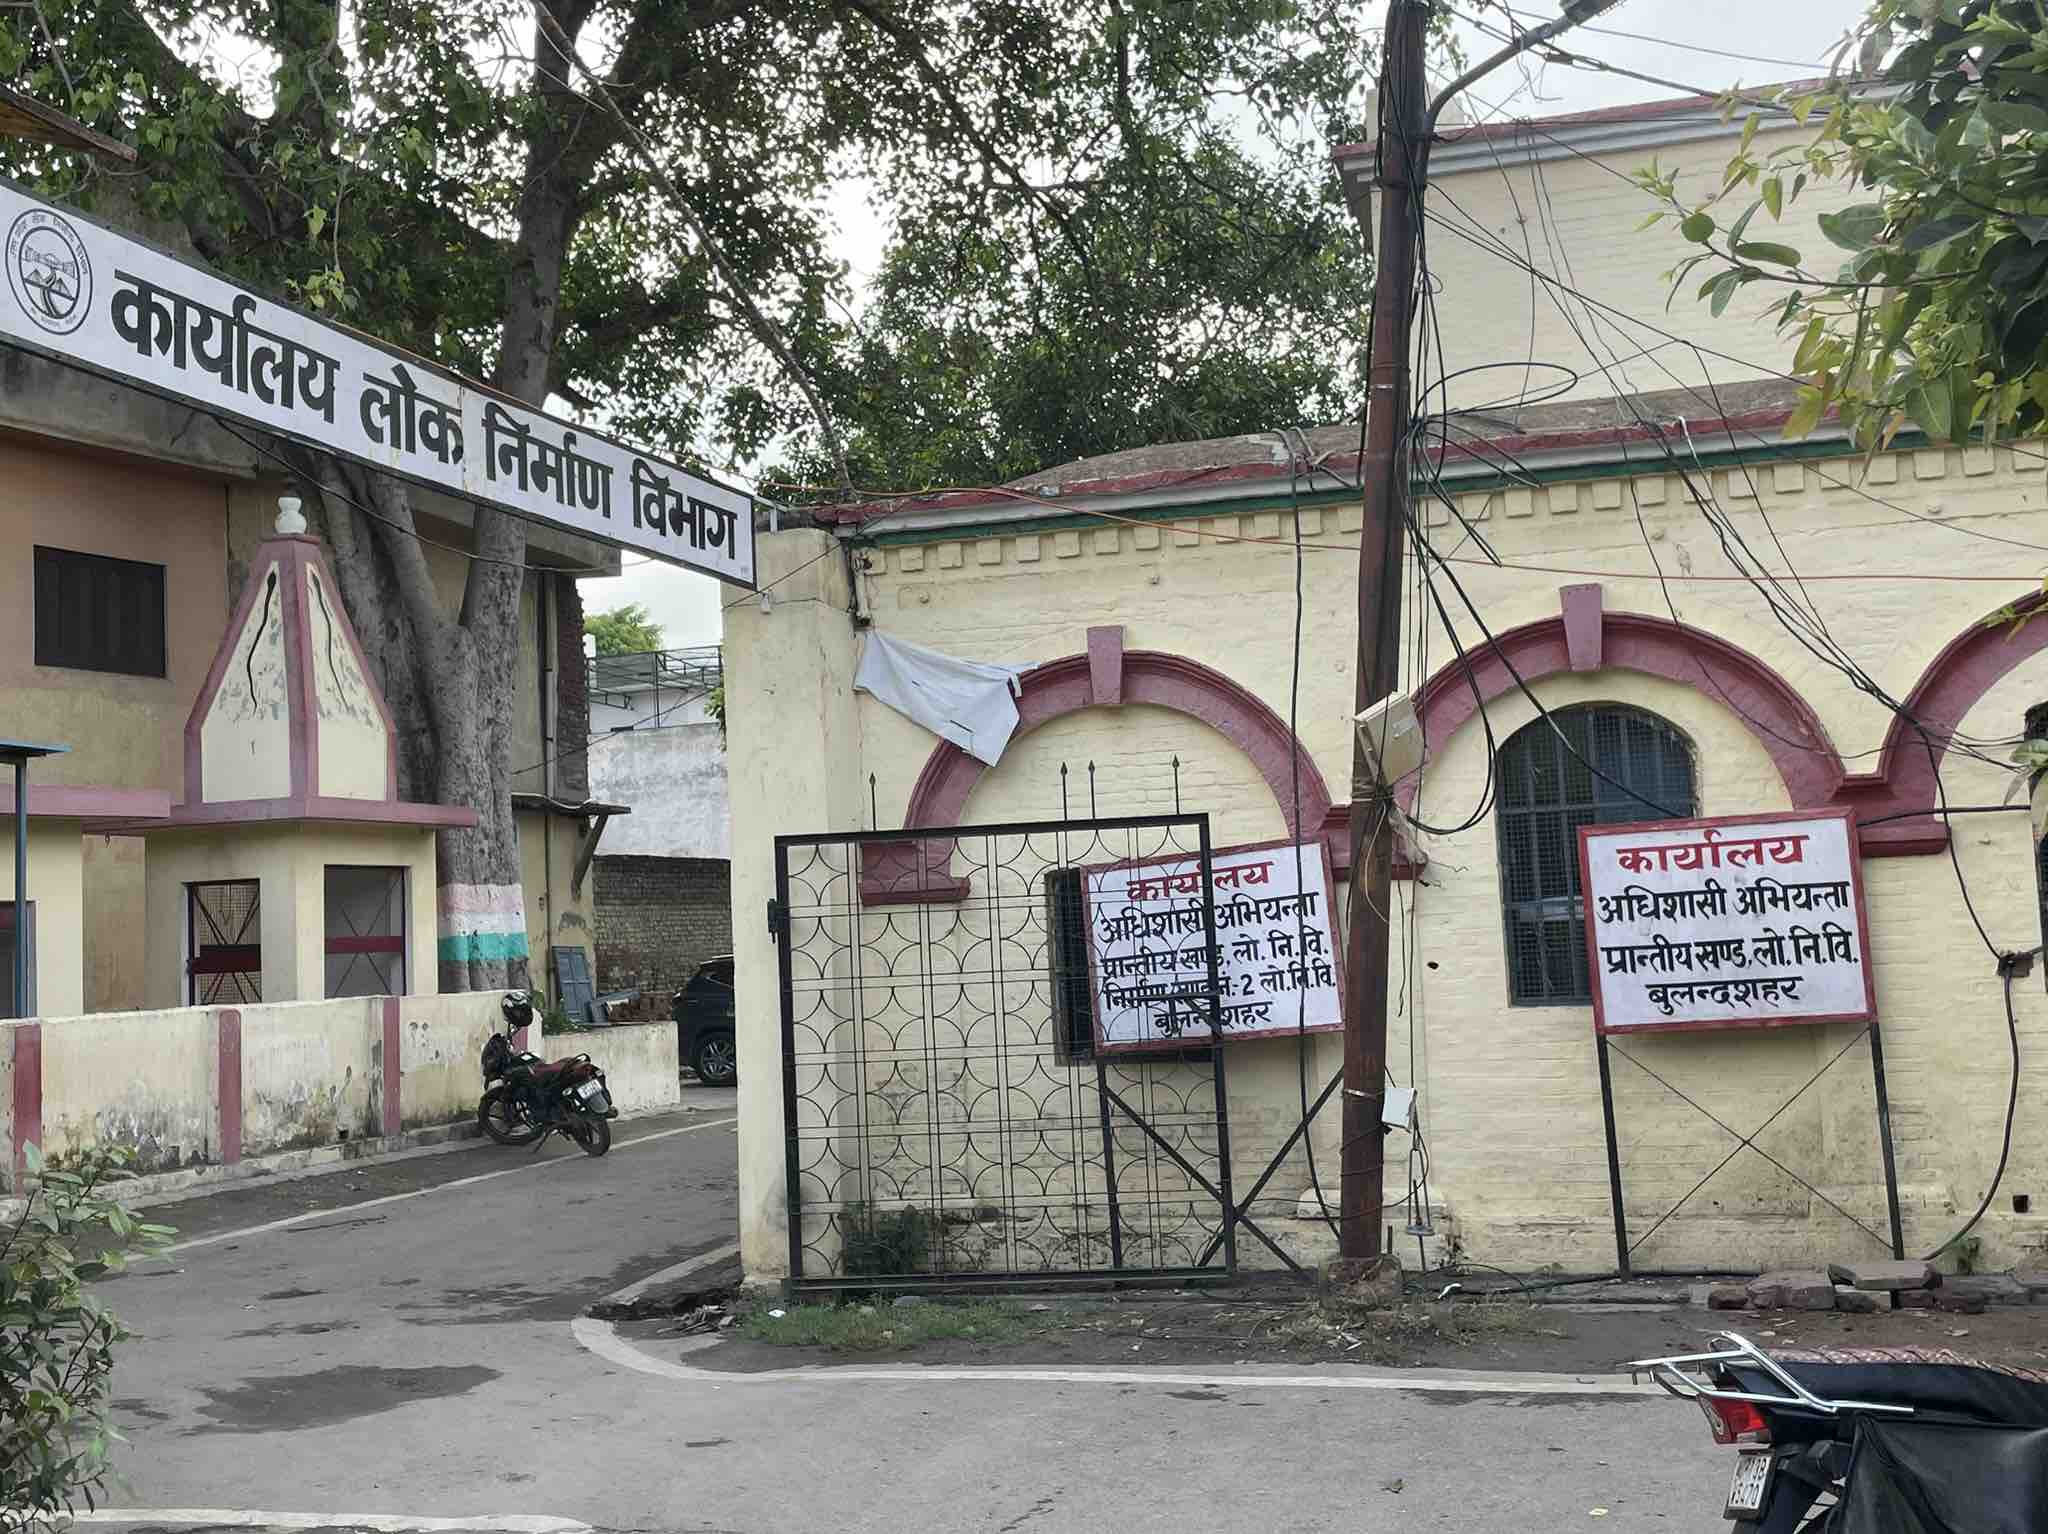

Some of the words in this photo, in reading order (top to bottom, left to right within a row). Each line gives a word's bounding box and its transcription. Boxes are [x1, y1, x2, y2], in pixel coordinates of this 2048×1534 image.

[111, 269, 340, 424] कार्यालय
[360, 363, 464, 464] लोक
[481, 402, 613, 519] निर्माण
[630, 459, 738, 560] विभाग
[1616, 829, 1809, 873] कार्यालय
[1214, 893, 1320, 929] अभियन्ता
[1597, 878, 1727, 924] अधिशासी
[1734, 877, 1850, 915] अभियन्ता
[1600, 934, 1693, 974] प्रान्तीय
[1645, 976, 1804, 1016] बुलन्दशहर
